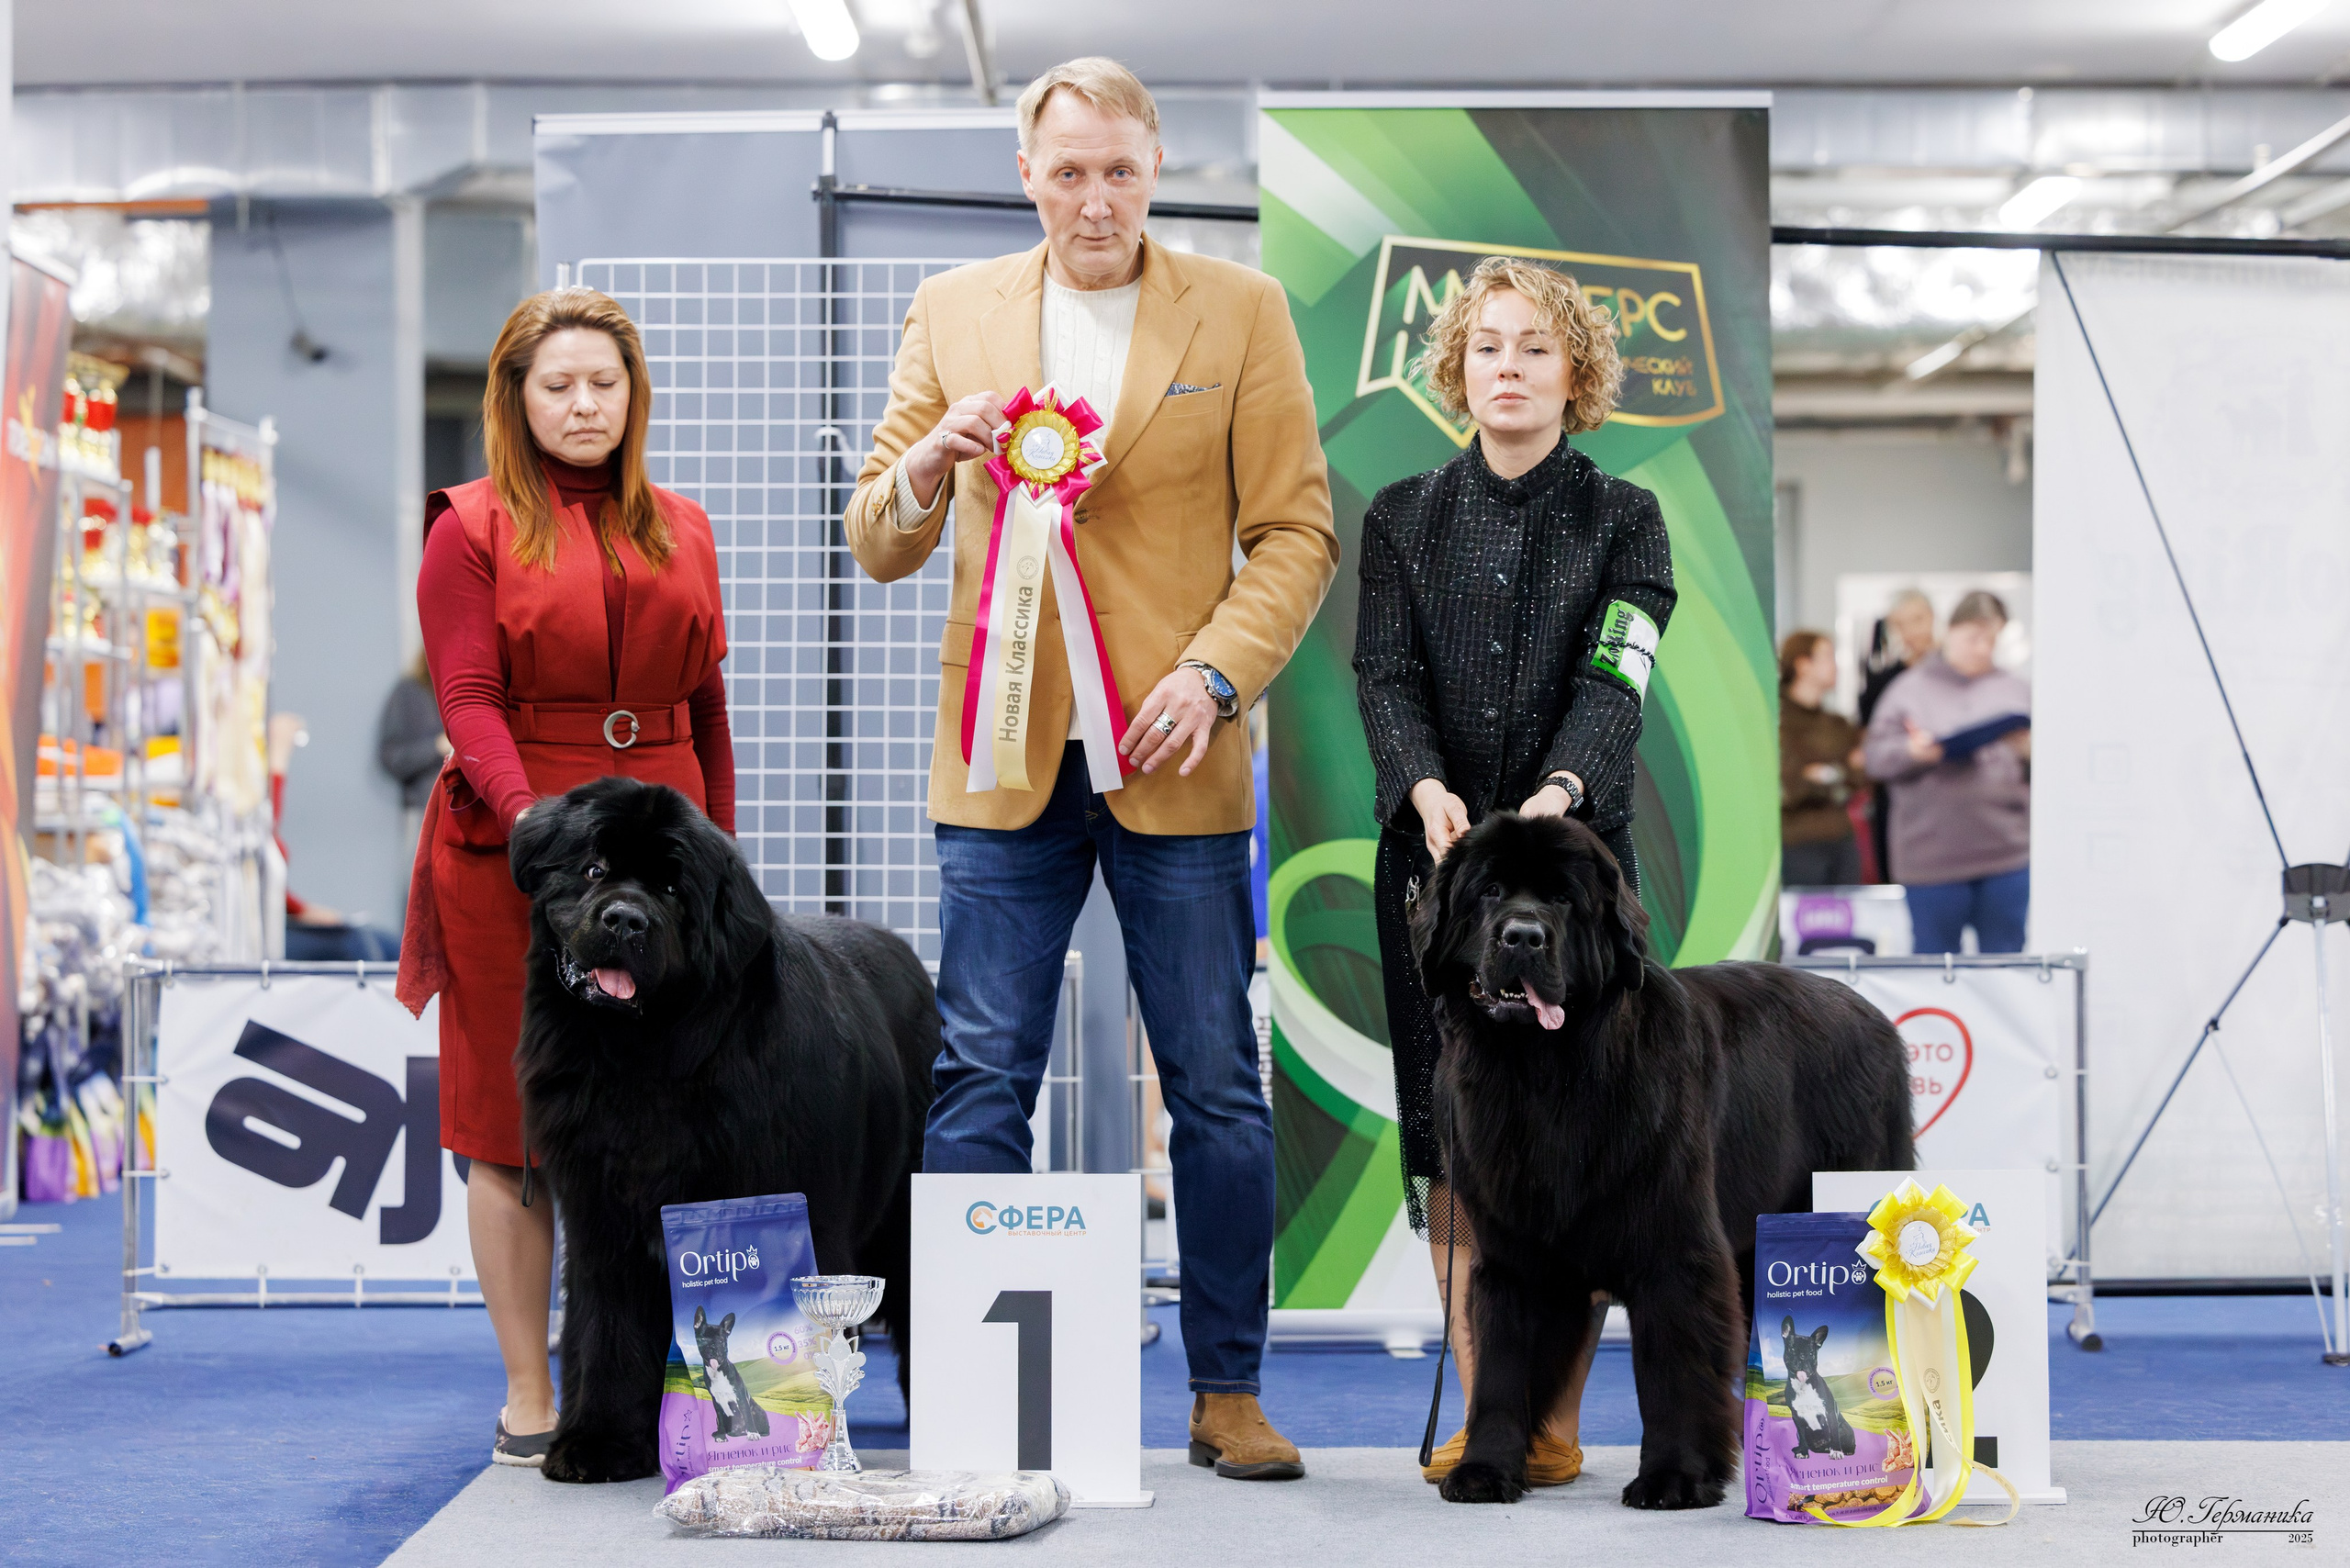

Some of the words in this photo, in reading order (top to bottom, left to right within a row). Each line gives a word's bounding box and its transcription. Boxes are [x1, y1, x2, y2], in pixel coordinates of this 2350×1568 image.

[1005, 585, 1035, 678] Классика
[998, 681, 1023, 743] Новая
[966, 1200, 1086, 1235] СФЕРА
[682, 1280, 703, 1288] holistic
[704, 1279, 713, 1287] pet
[1767, 1260, 1867, 1295] Ortipo
[1767, 1290, 1791, 1298] holistic
[1793, 1290, 1804, 1298] pet
[794, 1324, 813, 1334] 60%
[798, 1337, 817, 1348] 35%
[981, 1290, 1052, 1471] 1
[708, 1449, 758, 1462] Ягненок
[761, 1447, 768, 1456] и
[771, 1444, 791, 1457] рис
[777, 1456, 802, 1466] control
[1856, 1463, 1878, 1476] рис
[1790, 1483, 1811, 1491] smart
[1812, 1479, 1860, 1491] temperature
[1861, 1475, 1888, 1485] control
